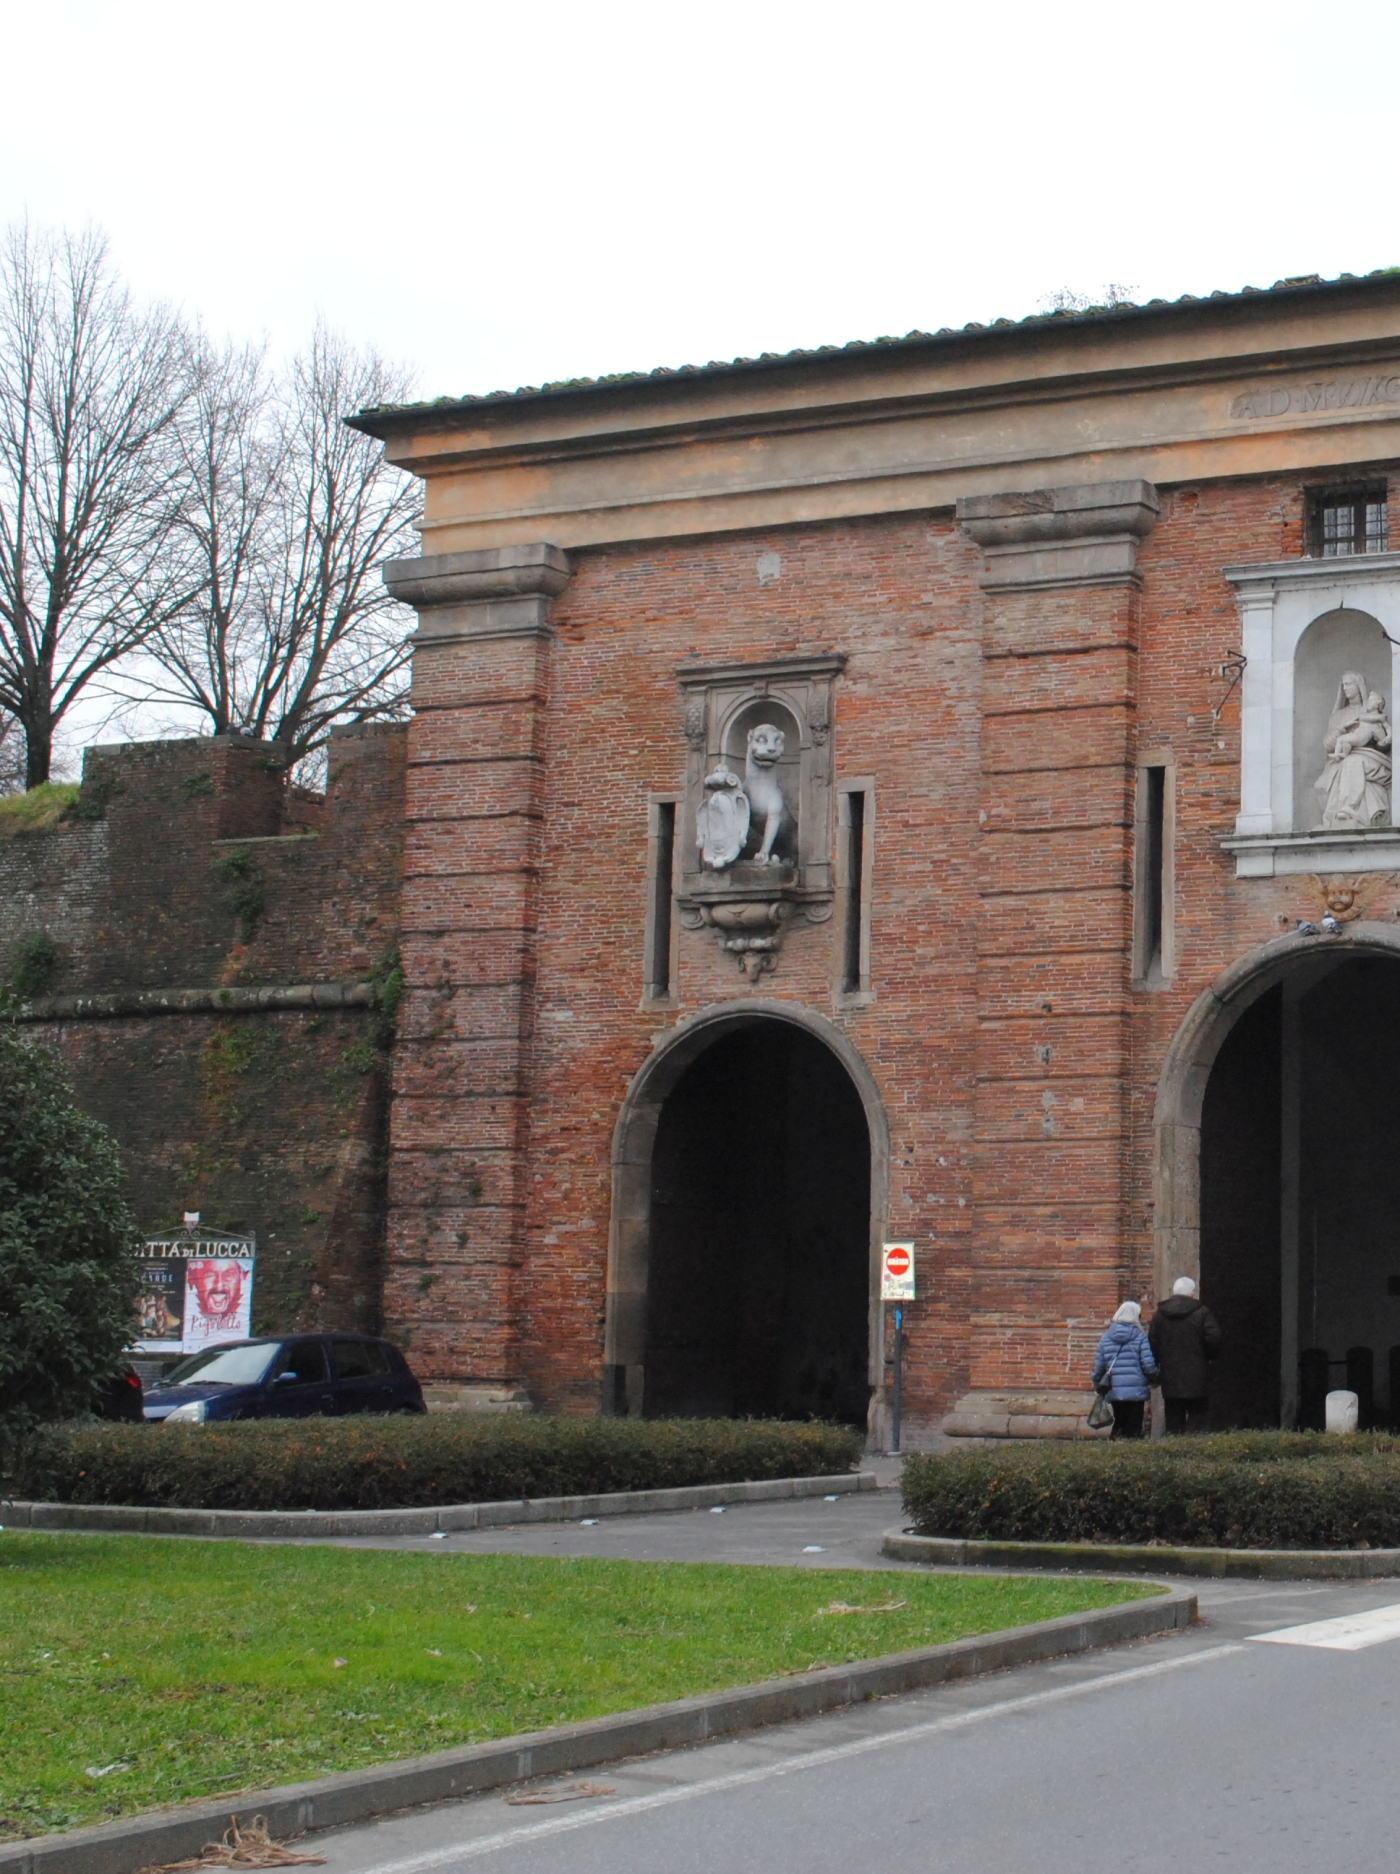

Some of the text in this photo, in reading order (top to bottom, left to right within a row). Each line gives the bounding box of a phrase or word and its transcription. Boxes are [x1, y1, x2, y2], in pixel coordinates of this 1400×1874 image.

[182, 1249, 194, 1257] DI
[195, 1241, 250, 1257] LUCCA
[191, 1314, 241, 1336] Rigoletto
